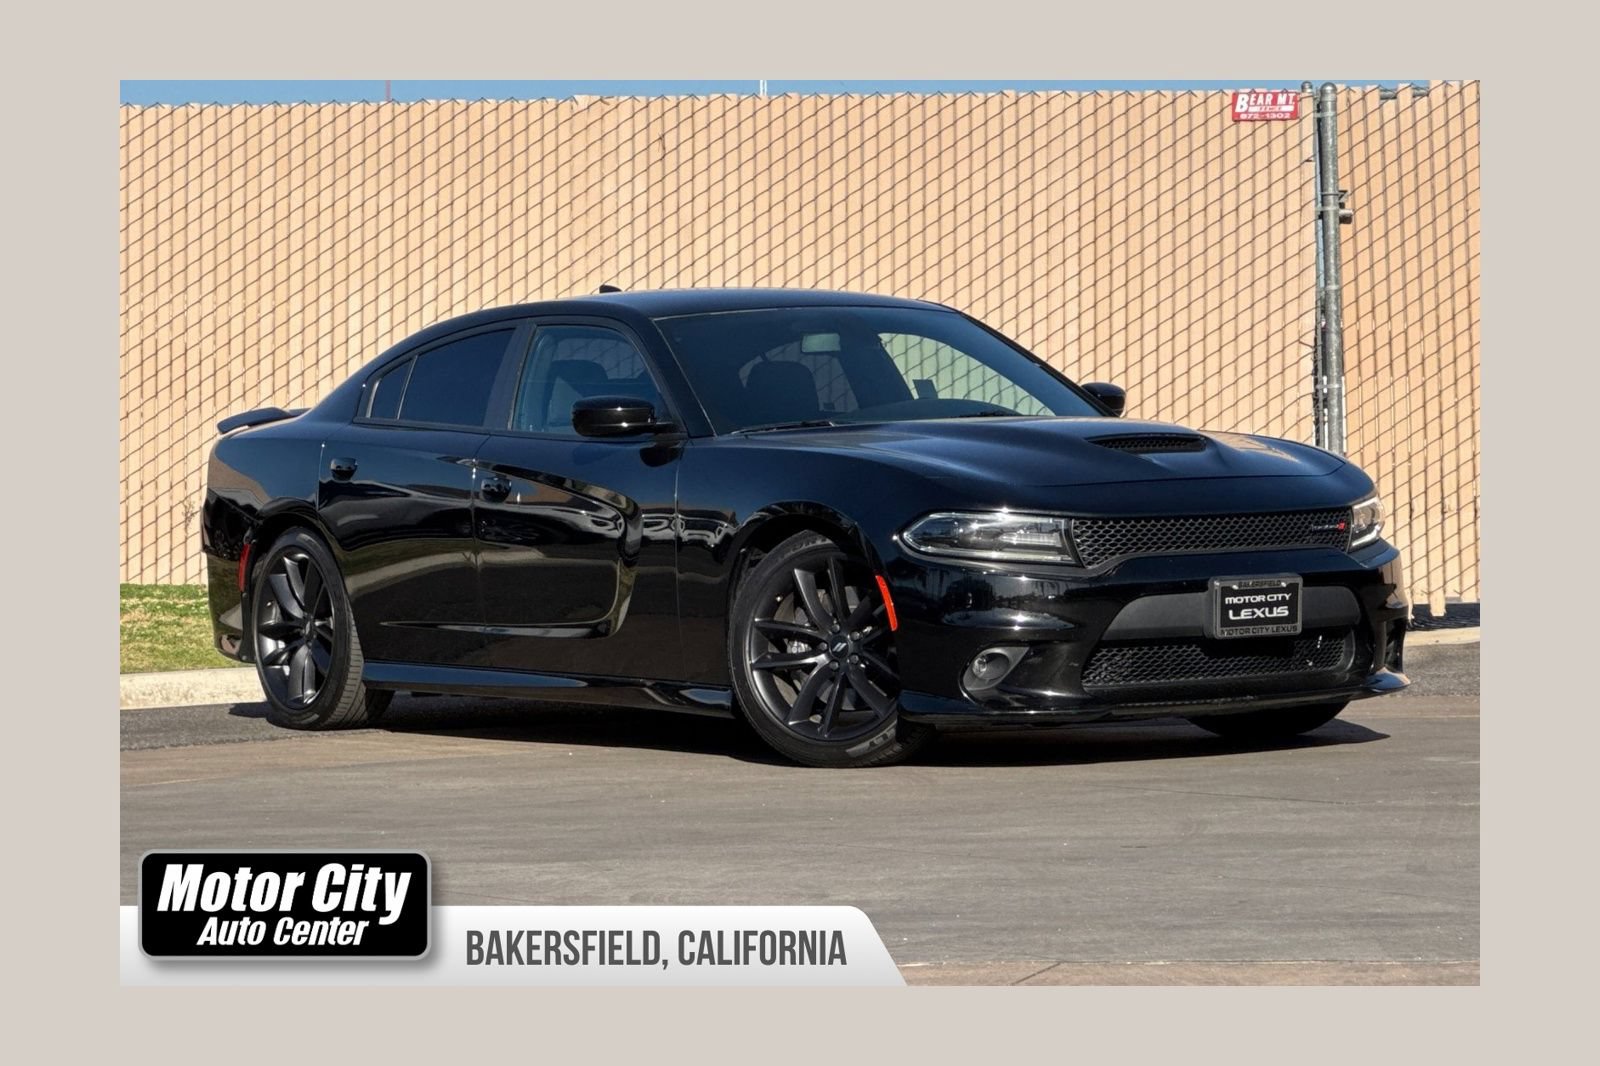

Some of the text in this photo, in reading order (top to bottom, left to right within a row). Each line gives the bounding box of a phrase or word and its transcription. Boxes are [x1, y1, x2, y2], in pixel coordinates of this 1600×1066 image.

[1235, 93, 1273, 112] BEAR
[1225, 593, 1292, 604] MOTOR CITY
[1229, 606, 1289, 620] LEXUS
[1221, 624, 1298, 636] MOTOR CITY LEXUS
